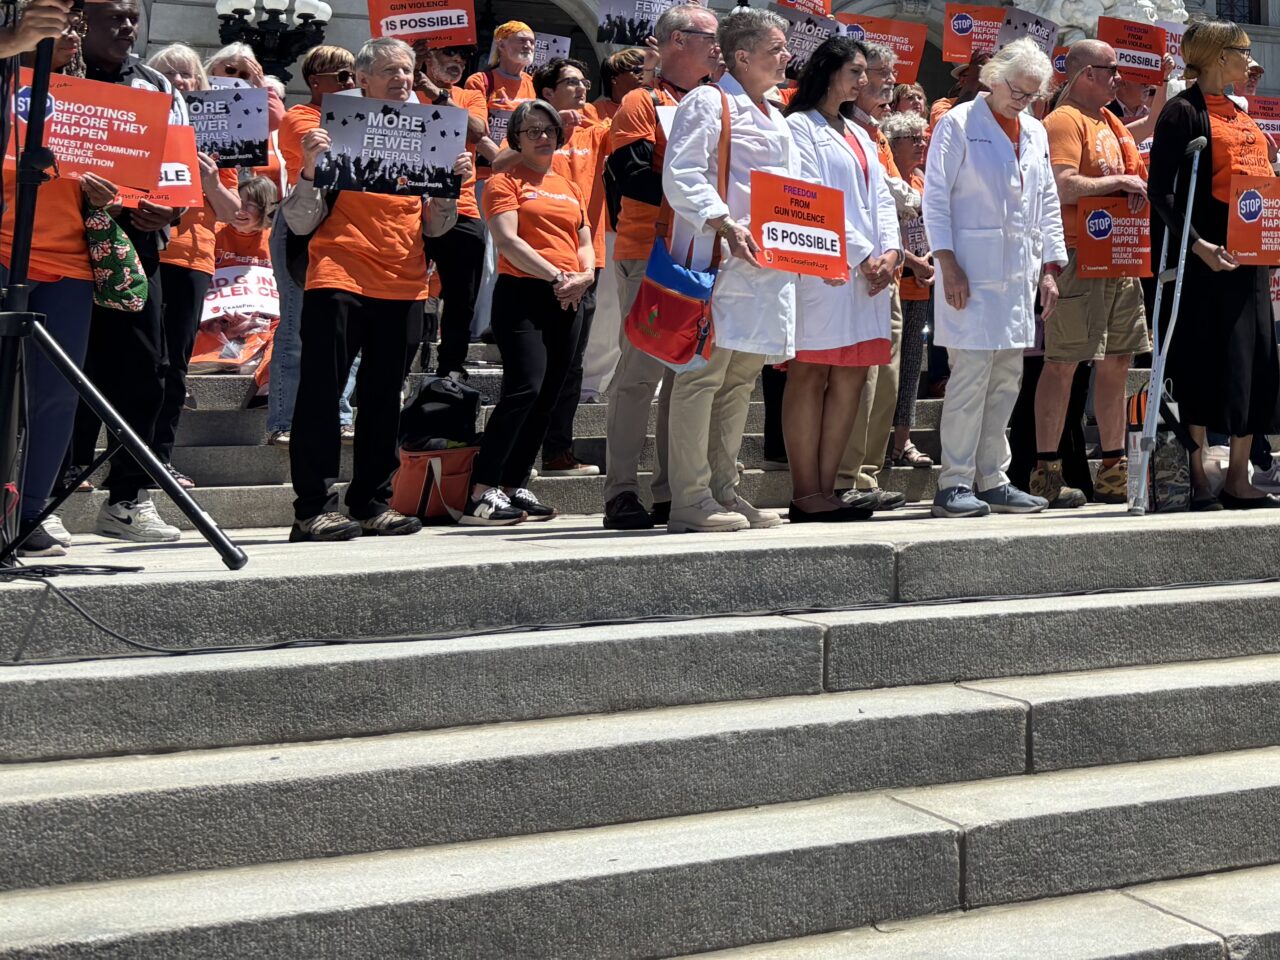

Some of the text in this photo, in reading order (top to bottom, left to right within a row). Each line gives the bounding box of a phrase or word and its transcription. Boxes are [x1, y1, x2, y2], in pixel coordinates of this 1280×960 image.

[390, 0, 449, 11] GUN VIOLENCE
[385, 14, 465, 31] IS POSSIBLE
[794, 21, 831, 39] MORE
[954, 20, 972, 29] STOP
[866, 31, 909, 44] SHOOTINGS
[1028, 23, 1050, 40] MORE
[896, 41, 914, 52] THEY
[1119, 52, 1160, 68] POSSIBLE
[54, 100, 137, 122] SHOOTINGS
[189, 100, 228, 114] ORE
[53, 112, 148, 135] BEFORE THEY
[367, 112, 424, 131] MORE
[50, 123, 108, 141] HAPPEN
[195, 131, 229, 141] ERALS
[366, 127, 422, 139] GRADUATIONS
[48, 136, 150, 158] INVEST IN COMMUNITY
[363, 134, 422, 152] FEWER
[361, 149, 421, 163] FUNERALS
[783, 184, 817, 199] FREEDOM
[790, 197, 811, 209] FROM
[1240, 198, 1260, 214] STOP
[774, 205, 825, 224] GUN VIOLENCE
[1112, 217, 1150, 226] SHOOTINGS
[1089, 217, 1111, 232] STOP
[1112, 226, 1150, 236] BEFORE THE
[767, 226, 838, 253] IS POSSIBLE
[1112, 236, 1139, 244] HAPPEN
[1261, 230, 1280, 238] INVEST
